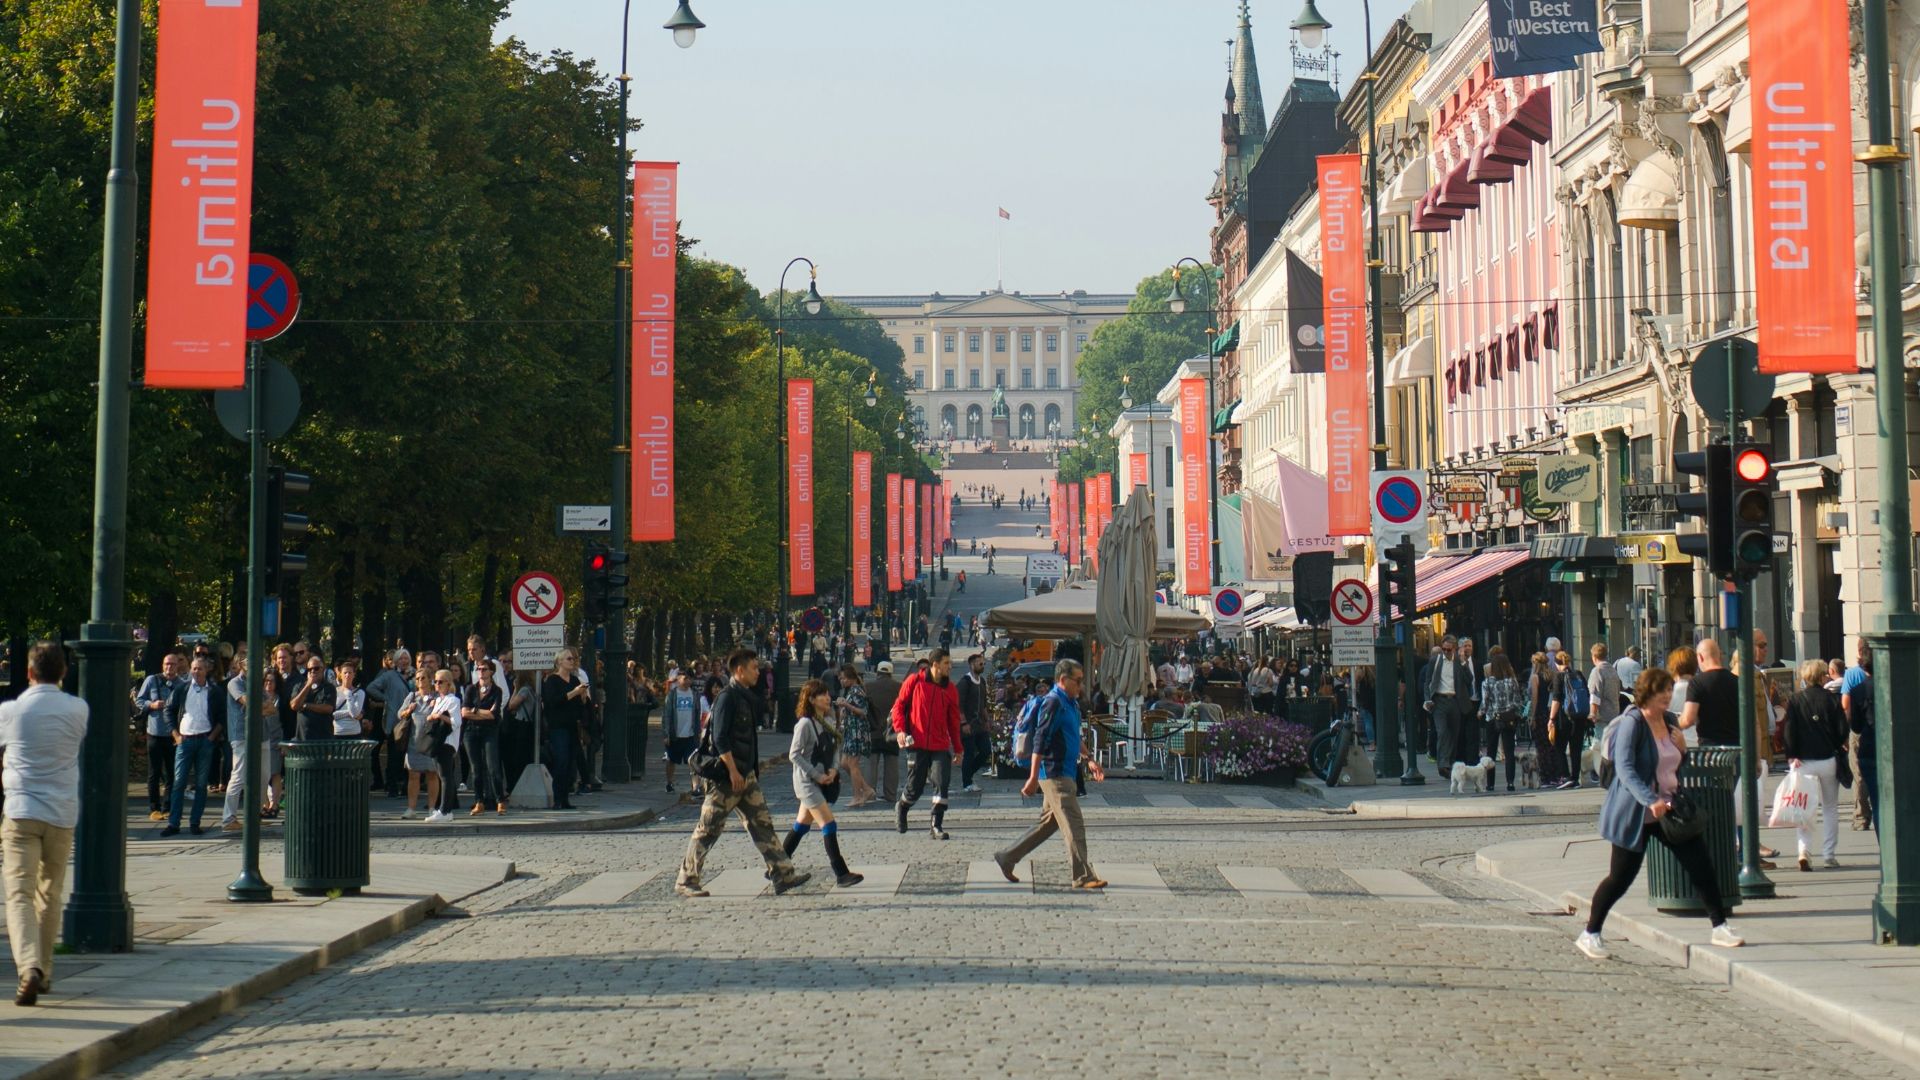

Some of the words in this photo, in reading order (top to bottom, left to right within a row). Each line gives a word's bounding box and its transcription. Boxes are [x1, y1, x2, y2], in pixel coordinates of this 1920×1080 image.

[1529, 0, 1571, 17] Best
[1514, 18, 1590, 36] Western
[1766, 82, 1836, 270] ultima
[1324, 169, 1356, 253] ultima
[1184, 386, 1201, 434] ultima
[1332, 409, 1362, 493] ultima
[1186, 453, 1204, 502] ultima
[1187, 522, 1205, 571] ultima
[1288, 537, 1336, 547] GESTUZ
[1620, 543, 1640, 558] Hotell
[1267, 564, 1292, 572] adidas
[527, 629, 550, 637] Gjelder
[520, 651, 542, 659] Gjelder
